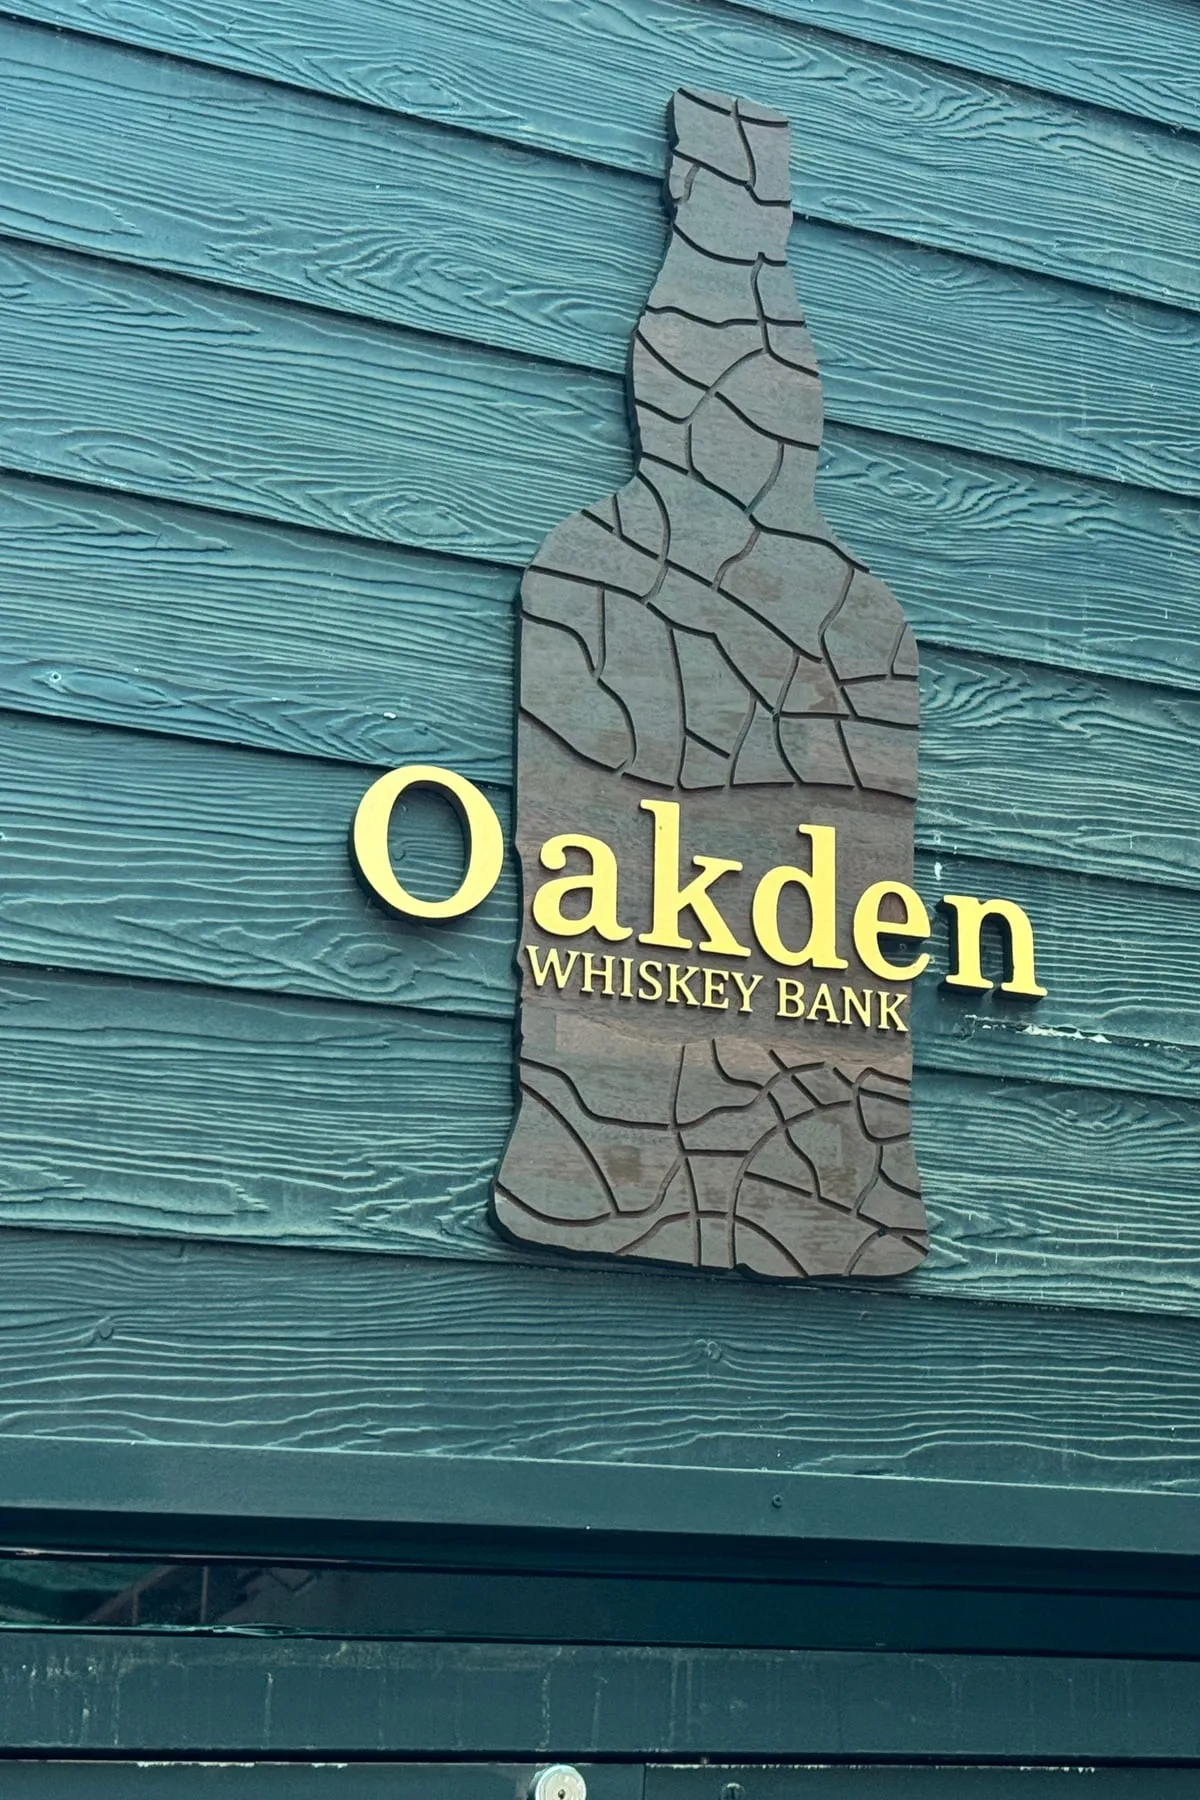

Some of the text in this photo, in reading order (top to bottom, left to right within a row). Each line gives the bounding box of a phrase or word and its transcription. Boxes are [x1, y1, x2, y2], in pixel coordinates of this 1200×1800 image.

[352, 765, 1048, 998] Oakden
[524, 943, 909, 1033] WHISKEY BANK
